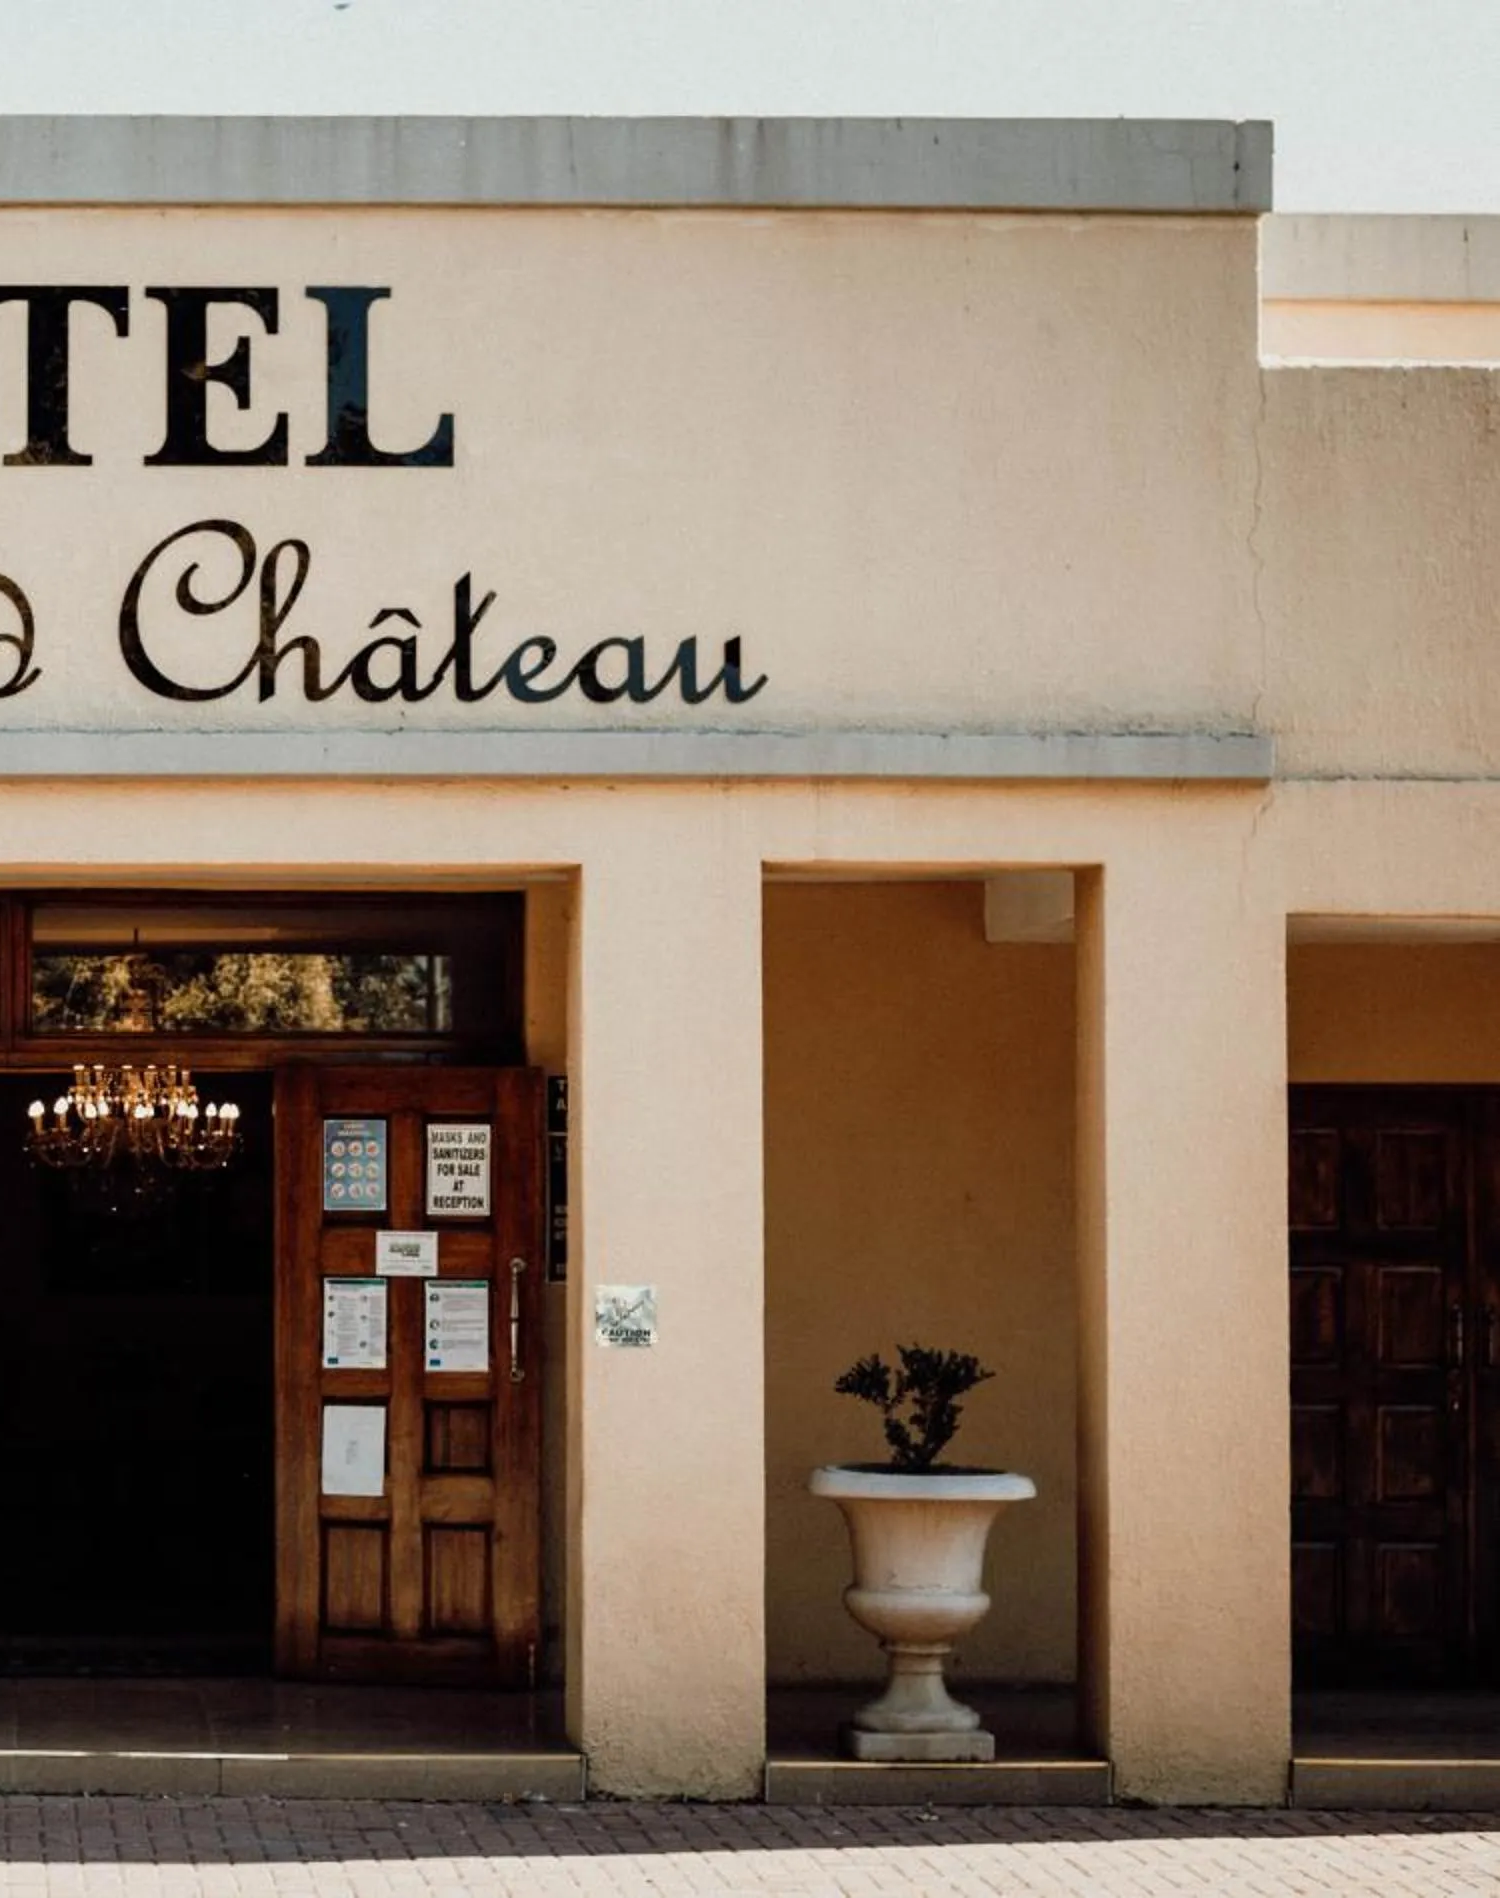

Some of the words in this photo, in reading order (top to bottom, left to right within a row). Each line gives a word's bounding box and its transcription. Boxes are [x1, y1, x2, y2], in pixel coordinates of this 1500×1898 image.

[119, 520, 767, 704] Château
[431, 1131, 463, 1143] MASKS
[468, 1131, 486, 1143] AND
[433, 1147, 485, 1160] SANITIZERS
[437, 1163, 454, 1176] FOR
[457, 1163, 481, 1176] SALE
[453, 1179, 465, 1192] AT
[433, 1196, 485, 1208] RECEPTION
[601, 1329, 651, 1337] CAUTION
